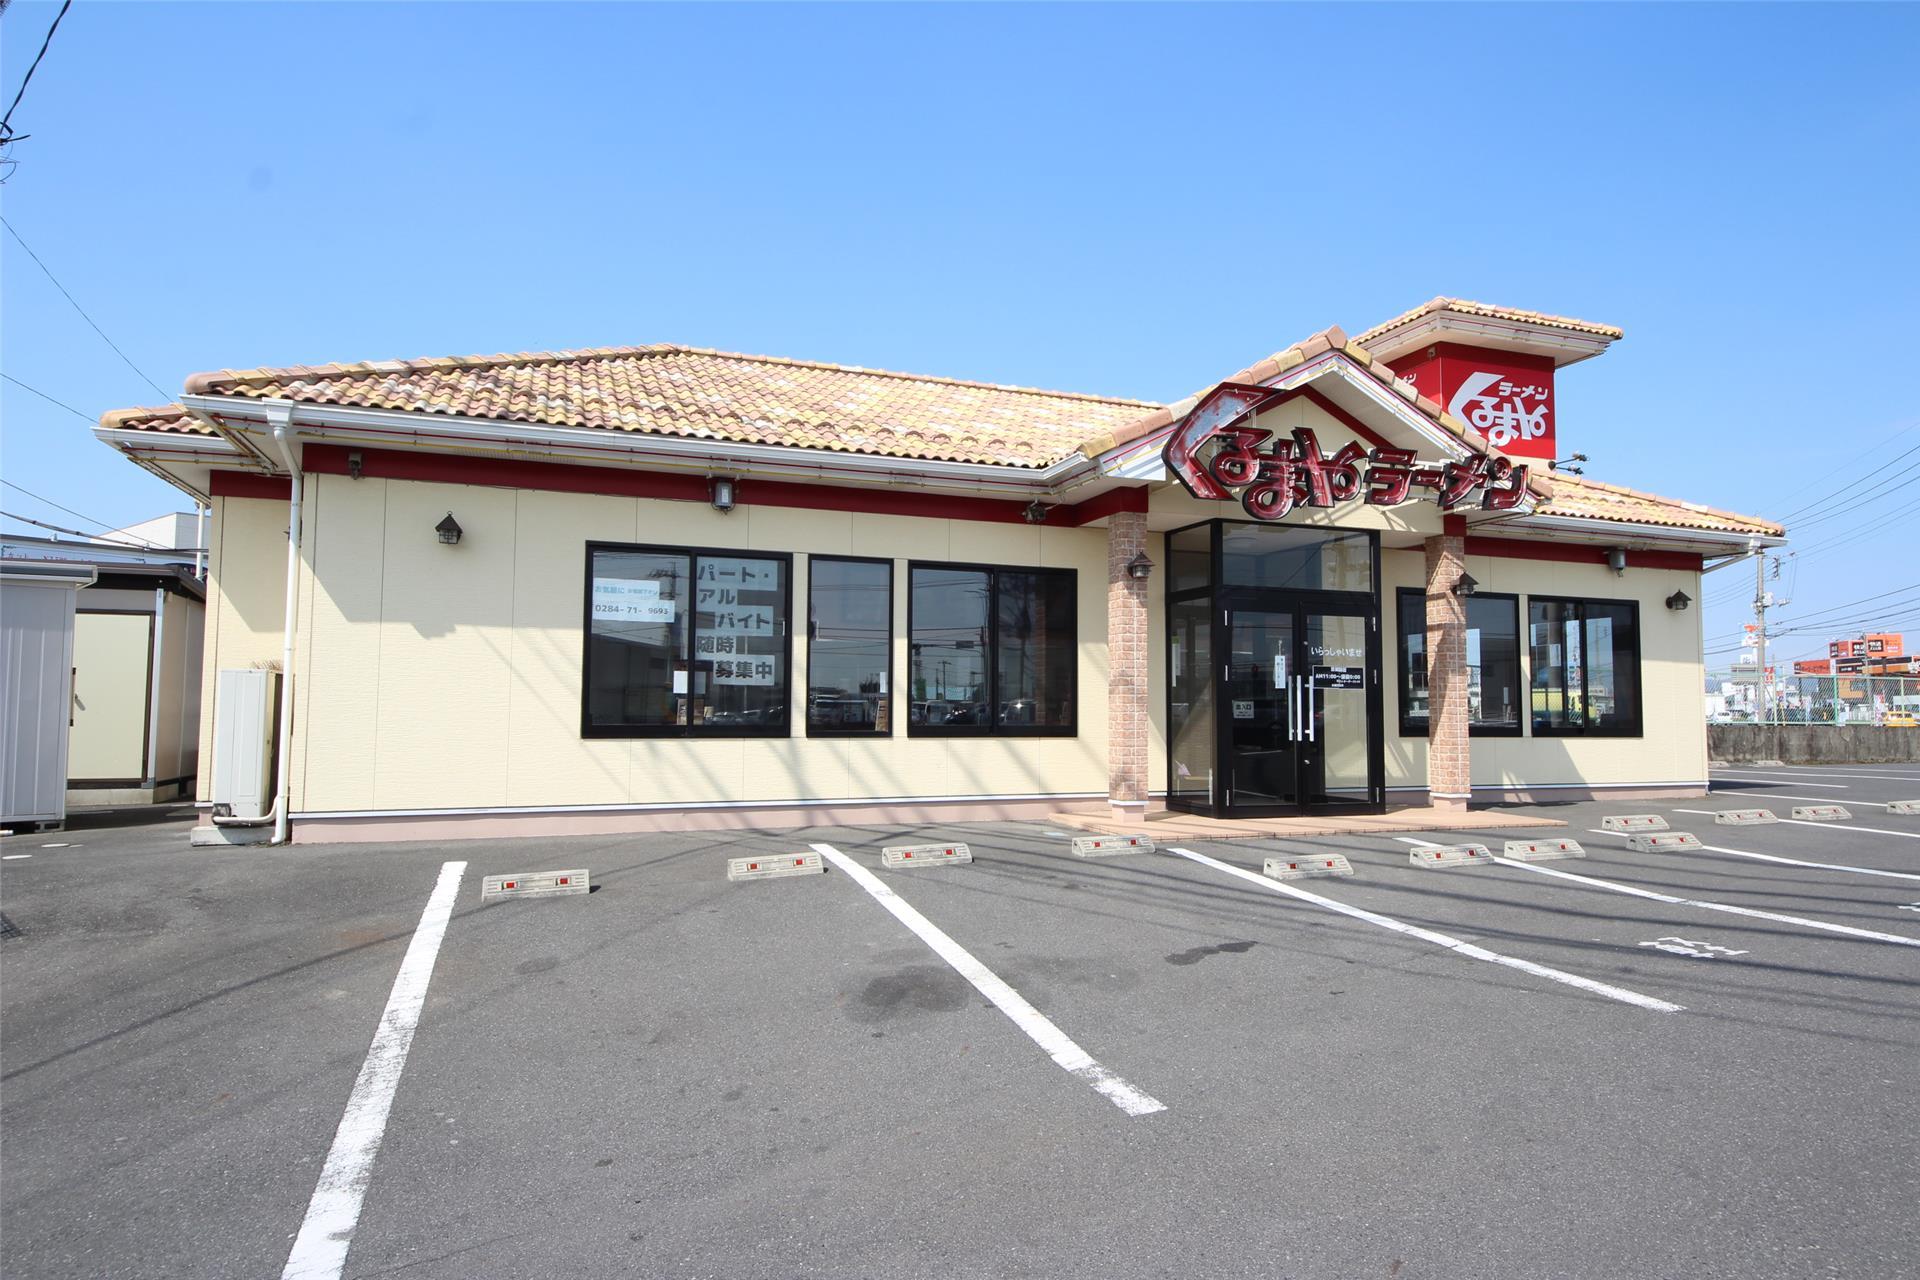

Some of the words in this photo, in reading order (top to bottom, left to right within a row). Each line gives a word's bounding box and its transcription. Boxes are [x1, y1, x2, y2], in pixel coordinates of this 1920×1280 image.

[1499, 381, 1548, 400] ラーメン
[1448, 371, 1550, 447] くるまや
[699, 588, 736, 605] アル
[717, 612, 770, 629] バイト
[697, 635, 734, 654] 随時
[1311, 646, 1363, 657] いらっしゃいませ
[715, 660, 773, 680] 募集中
